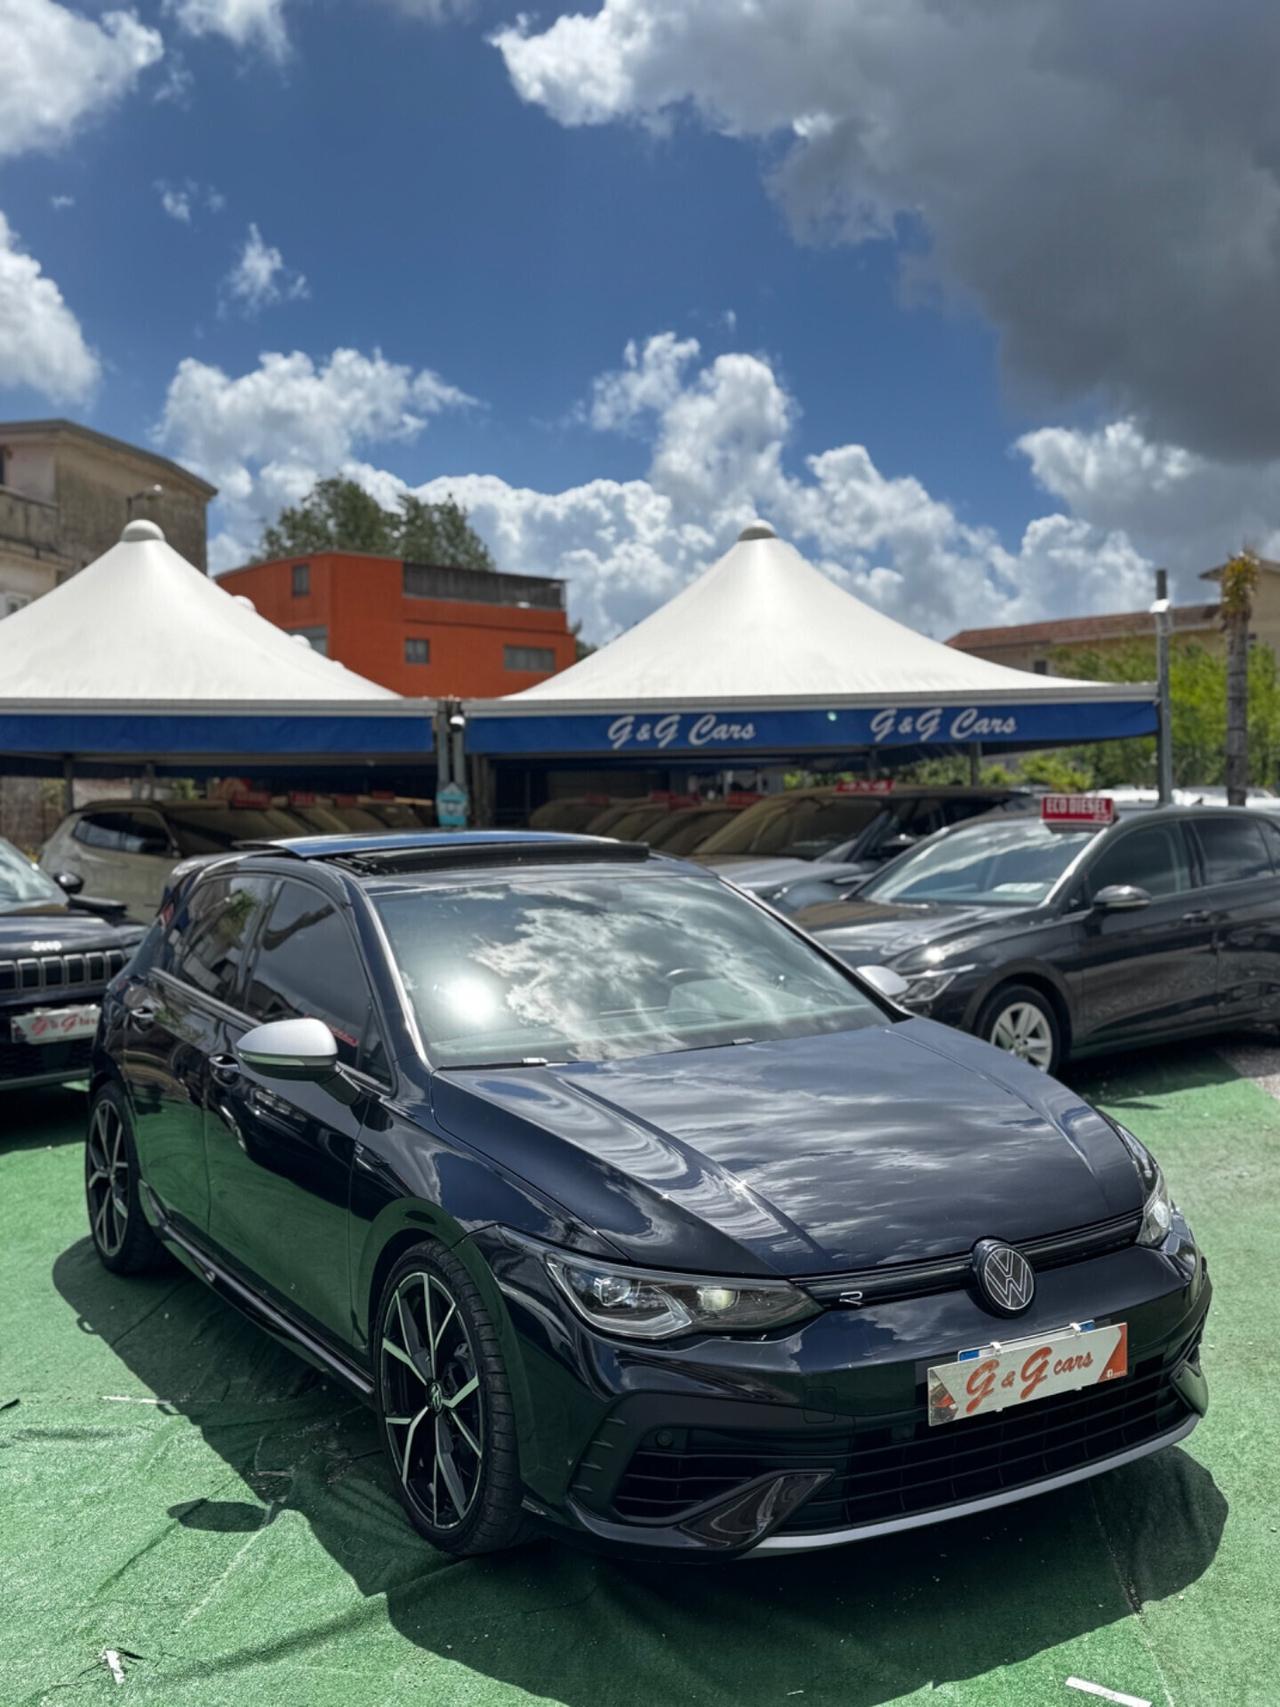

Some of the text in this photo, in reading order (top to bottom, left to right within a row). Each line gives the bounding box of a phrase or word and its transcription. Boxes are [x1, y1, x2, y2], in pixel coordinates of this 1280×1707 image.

[688, 713, 756, 746] Cars
[951, 708, 1017, 739] Cars
[1046, 798, 1105, 814] ECO DIESEL
[1053, 1351, 1094, 1376] cars
